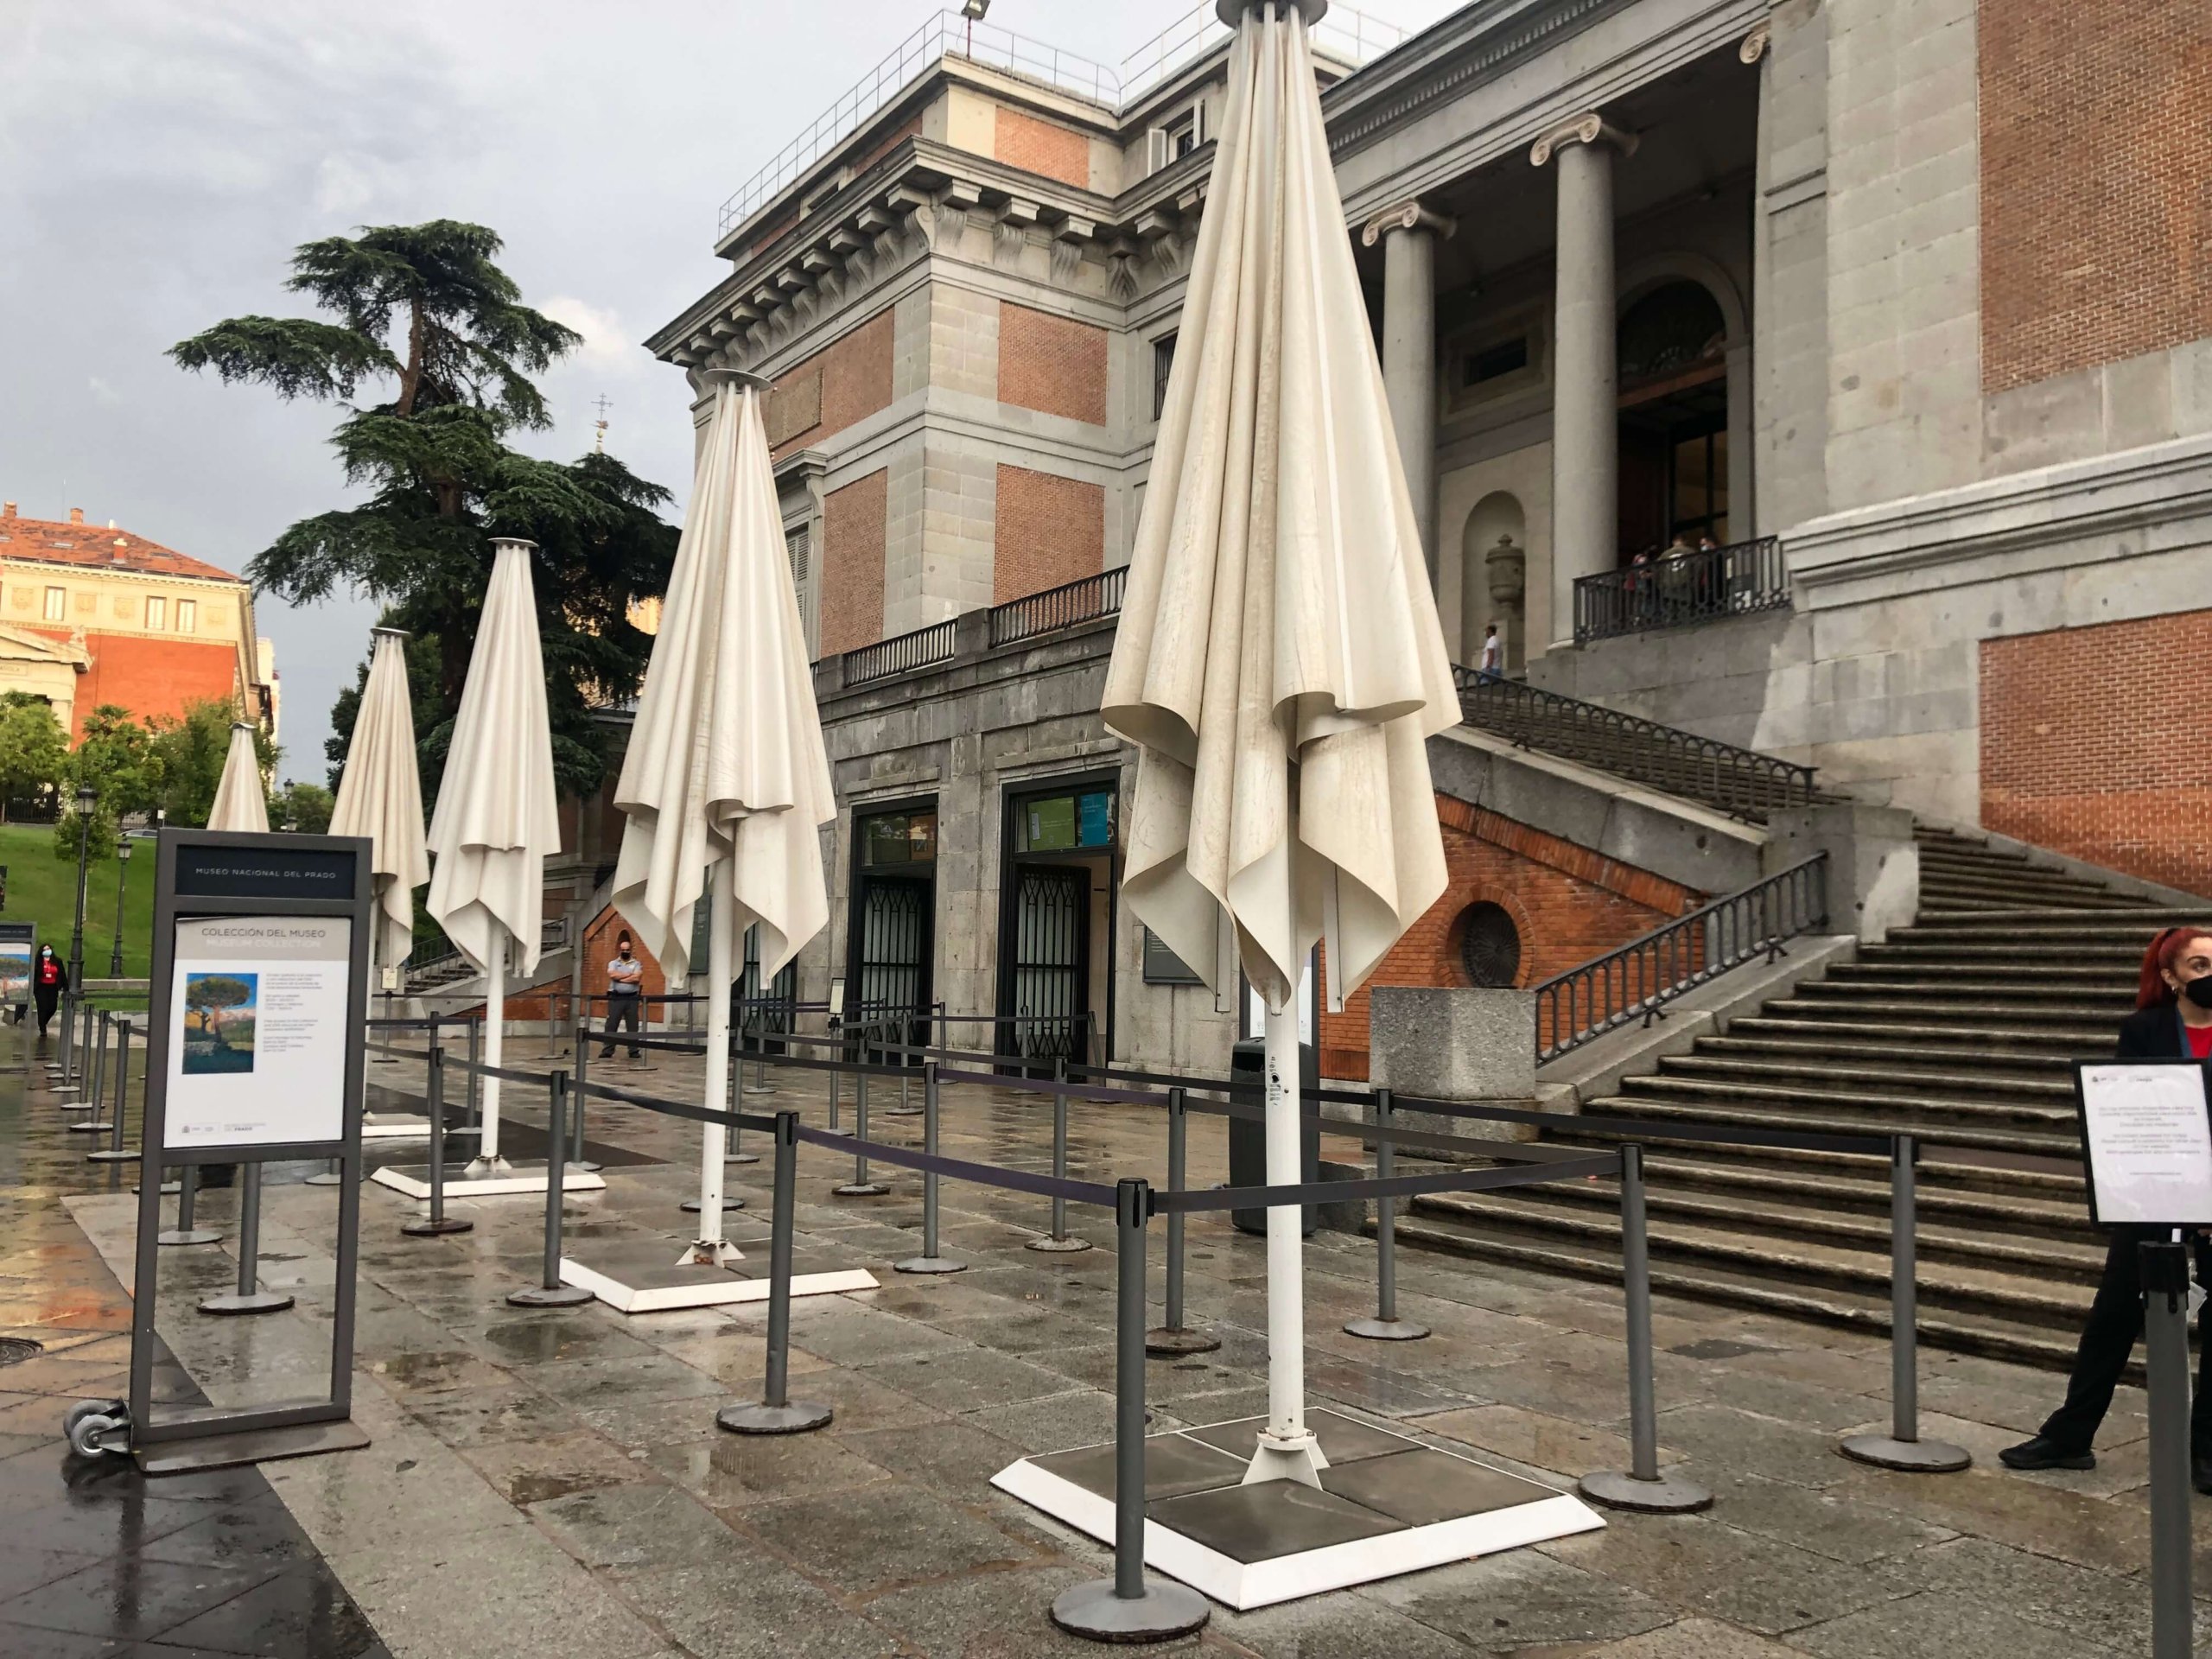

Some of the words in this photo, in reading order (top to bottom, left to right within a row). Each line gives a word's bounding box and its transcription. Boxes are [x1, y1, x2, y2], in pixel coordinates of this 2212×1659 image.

[232, 868, 280, 877] NACIONAL
[201, 926, 264, 938] COLECCIÓN
[266, 929, 287, 938] DEL
[289, 929, 326, 938] MUSEO
[206, 938, 252, 948] MUSEUM
[254, 938, 321, 948] COLLECTION
